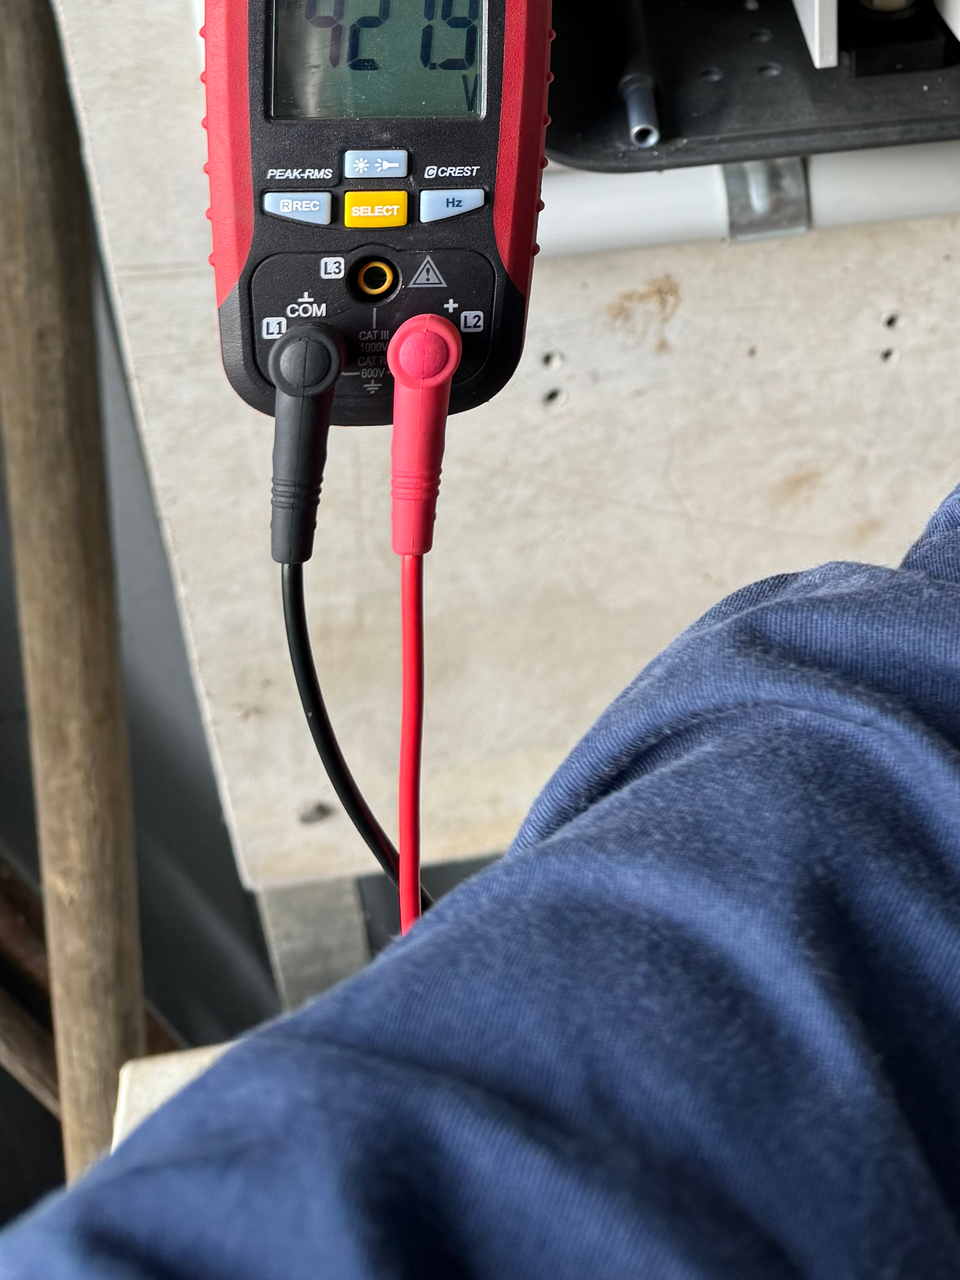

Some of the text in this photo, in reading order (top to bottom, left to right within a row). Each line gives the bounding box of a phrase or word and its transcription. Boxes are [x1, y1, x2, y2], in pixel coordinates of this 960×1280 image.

[267, 168, 333, 179] PEAK-RMS
[438, 166, 480, 178] CREST
[293, 200, 320, 211] REC
[446, 197, 463, 208] Hz
[351, 205, 400, 217] SELECT
[323, 260, 343, 276] L3
[286, 303, 327, 318] COM
[265, 320, 284, 335] L1
[463, 314, 482, 330] L2
[359, 330, 390, 340] CAT III
[358, 356, 377, 366] CAT
[361, 368, 385, 378] 600V
